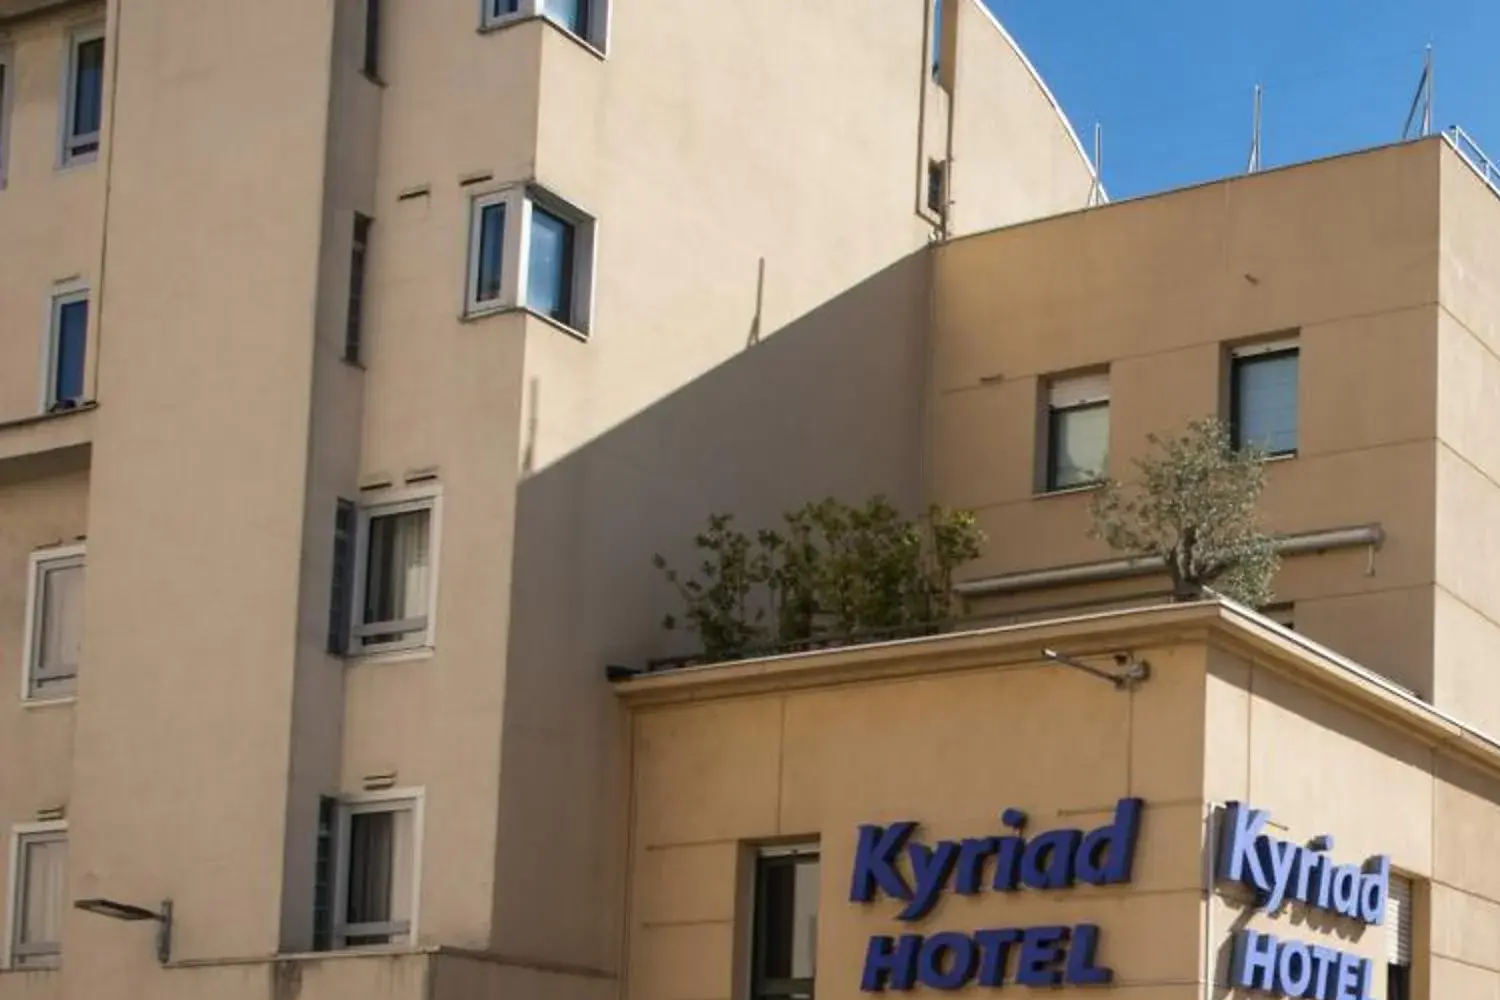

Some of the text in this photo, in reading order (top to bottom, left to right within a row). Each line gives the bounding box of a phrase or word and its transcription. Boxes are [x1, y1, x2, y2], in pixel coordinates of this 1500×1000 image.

[849, 798, 1143, 921] Kyriad
[1227, 801, 1391, 926] Kyriad
[860, 924, 1114, 992] HOTEL
